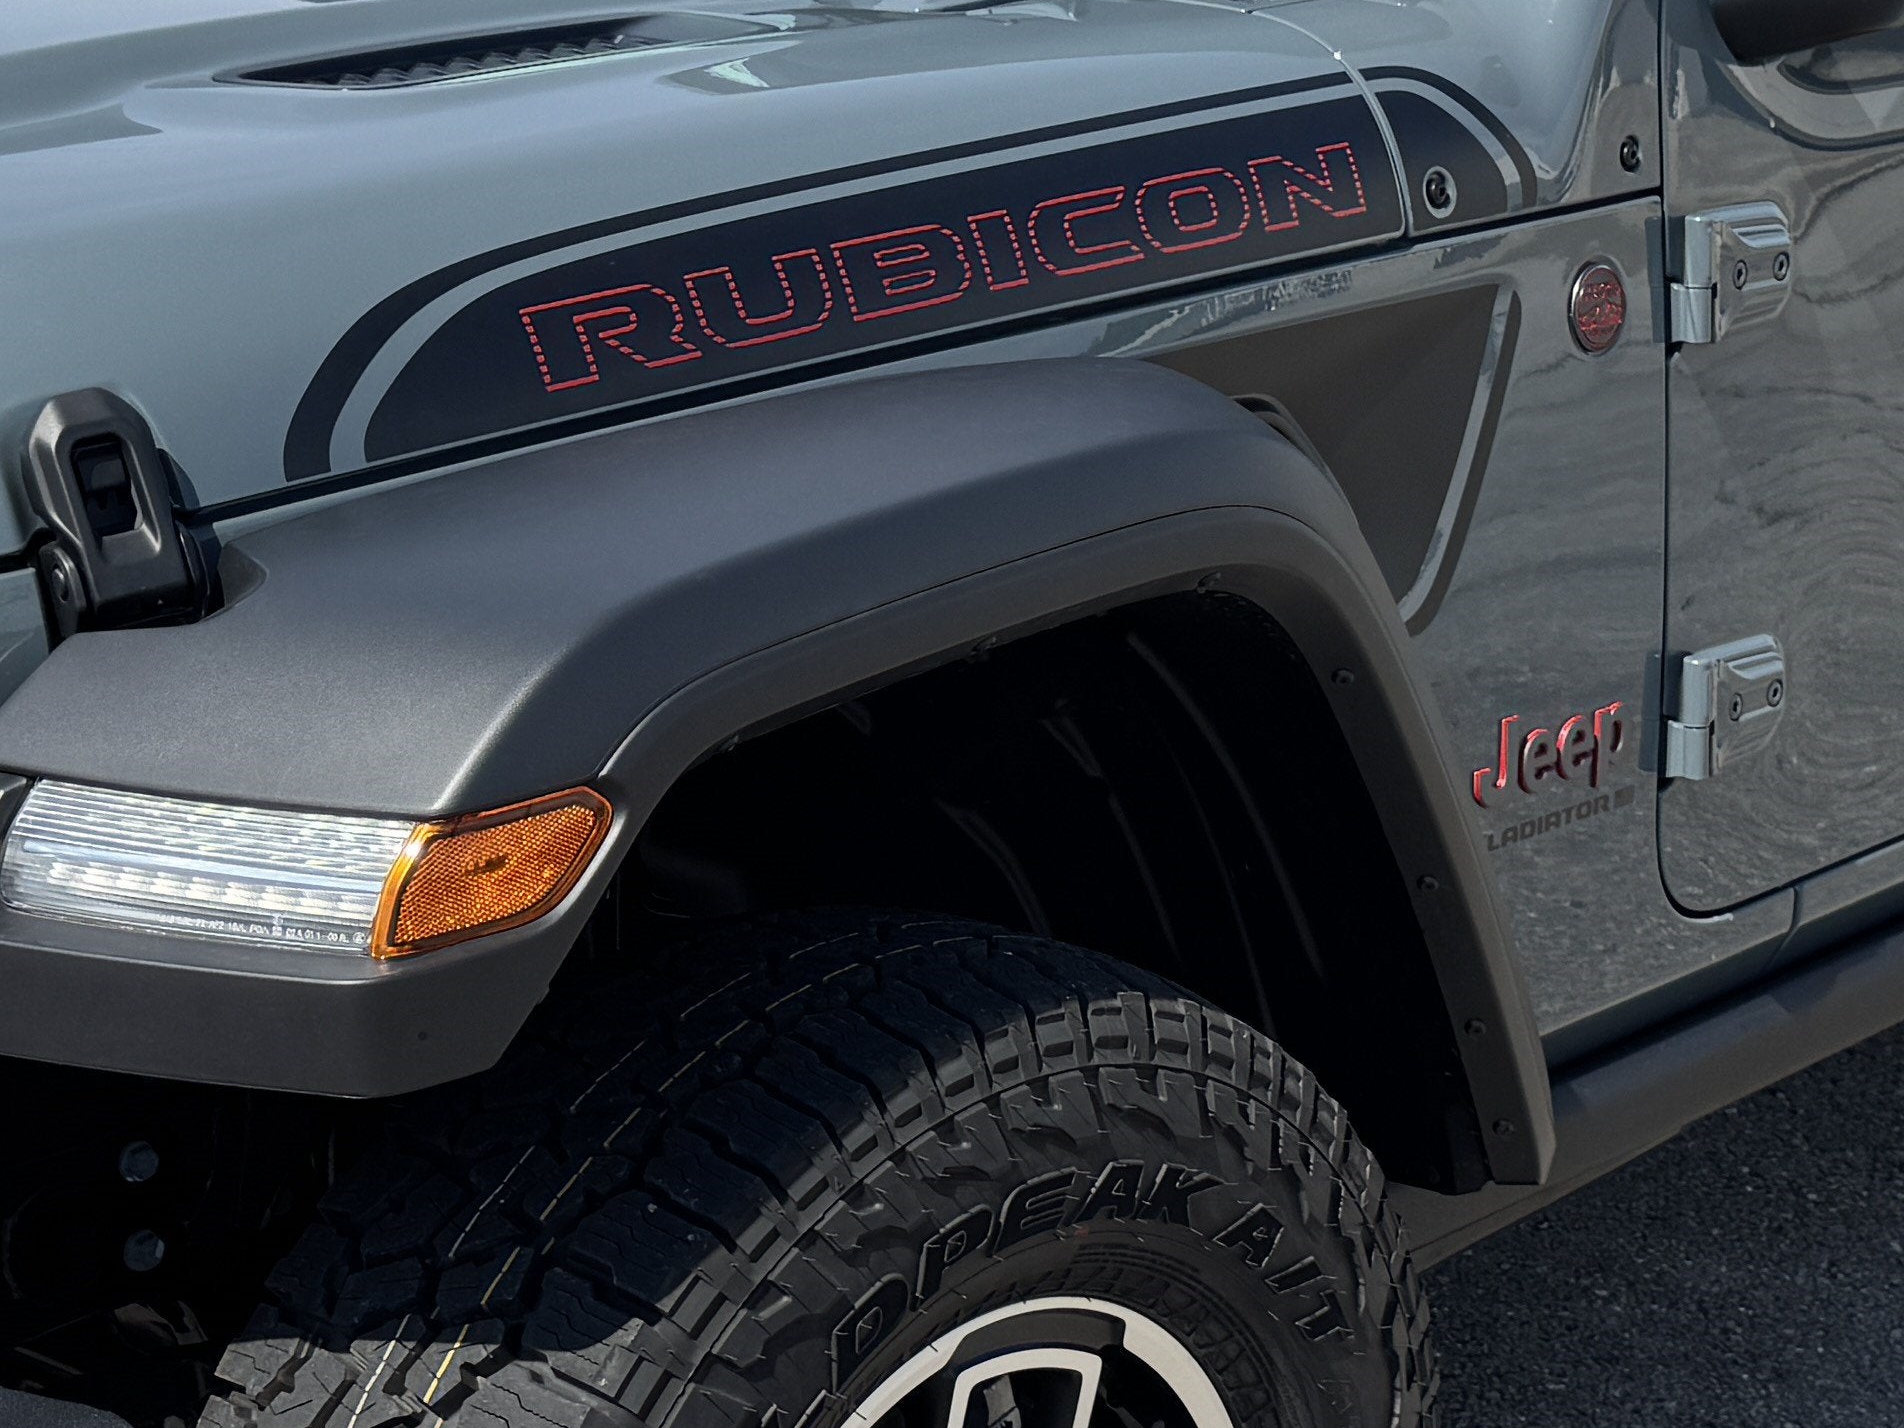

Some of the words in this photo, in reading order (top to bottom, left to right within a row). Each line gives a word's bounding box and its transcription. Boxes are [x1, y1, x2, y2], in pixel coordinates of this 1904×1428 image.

[518, 141, 1369, 392] RUBICON
[1472, 701, 1625, 810] Jeep
[1484, 794, 1610, 851] LADIATOR
